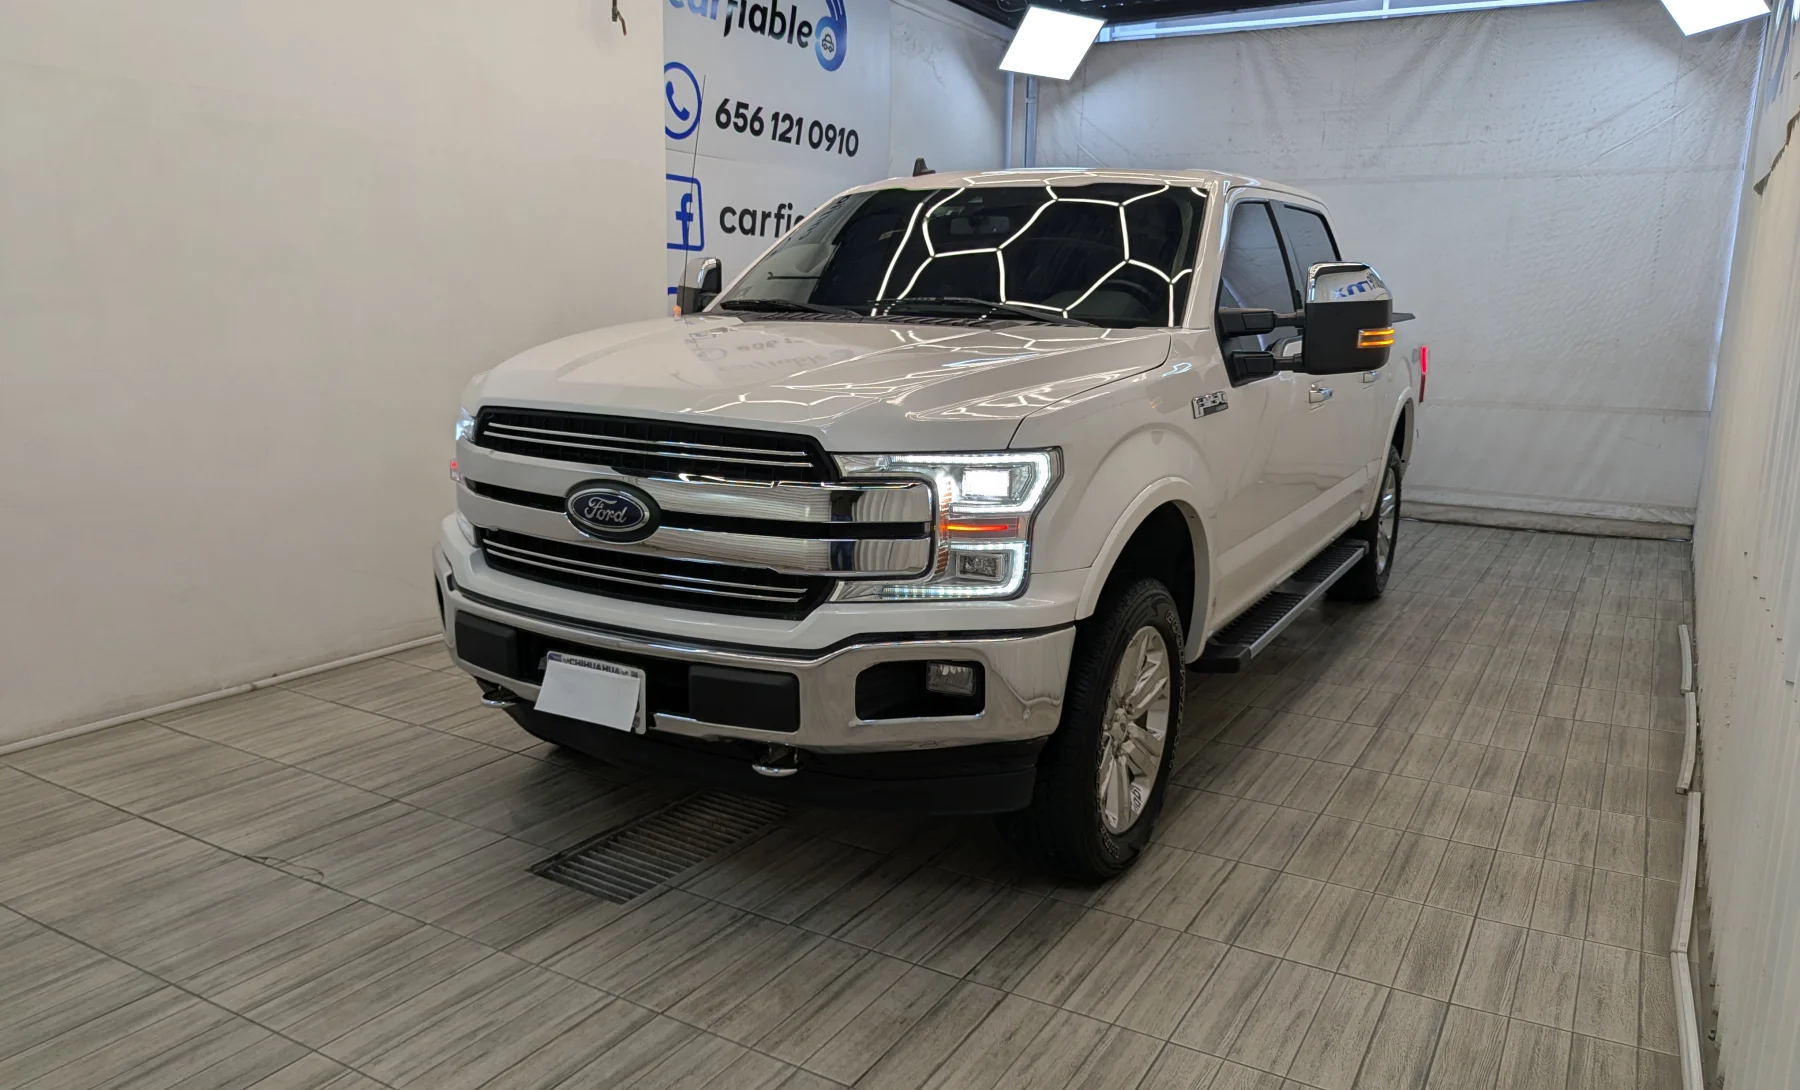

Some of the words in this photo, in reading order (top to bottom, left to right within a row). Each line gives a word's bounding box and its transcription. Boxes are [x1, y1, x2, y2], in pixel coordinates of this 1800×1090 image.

[668, 0, 813, 48] arfiable
[715, 98, 765, 137] 656
[771, 111, 802, 146] 121
[808, 119, 859, 157] 0910
[584, 496, 628, 523] Ford
[569, 658, 620, 675] CHIHUAHUA
